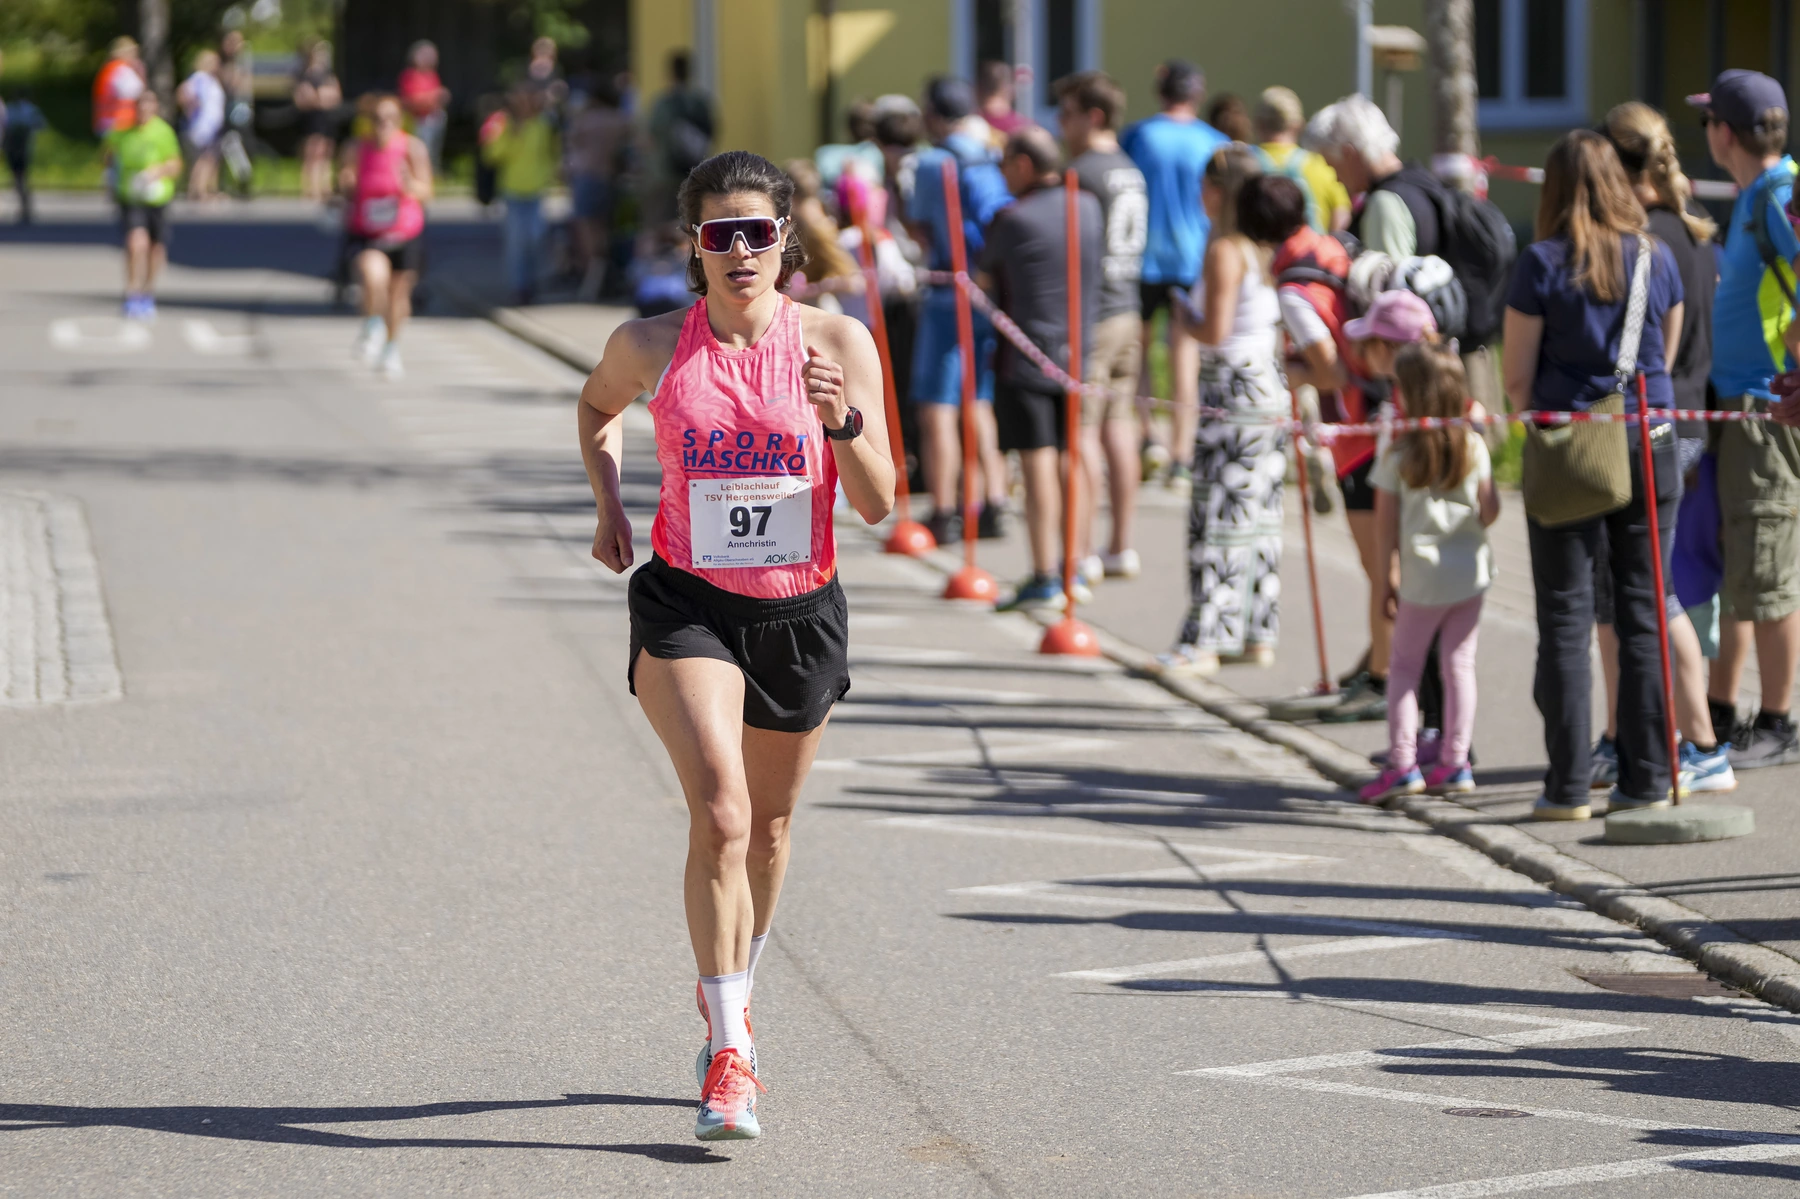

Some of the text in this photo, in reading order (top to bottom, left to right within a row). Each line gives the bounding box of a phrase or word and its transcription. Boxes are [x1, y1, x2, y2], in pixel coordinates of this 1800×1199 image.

[683, 429, 808, 453] SPORT
[683, 449, 806, 471] HASCHKO
[720, 481, 780, 491] Leiblachlauf
[704, 491, 796, 503] TSV Hergensweiler
[729, 505, 772, 537] 97
[727, 539, 777, 549] Annchristin
[763, 553, 788, 564] AOK
